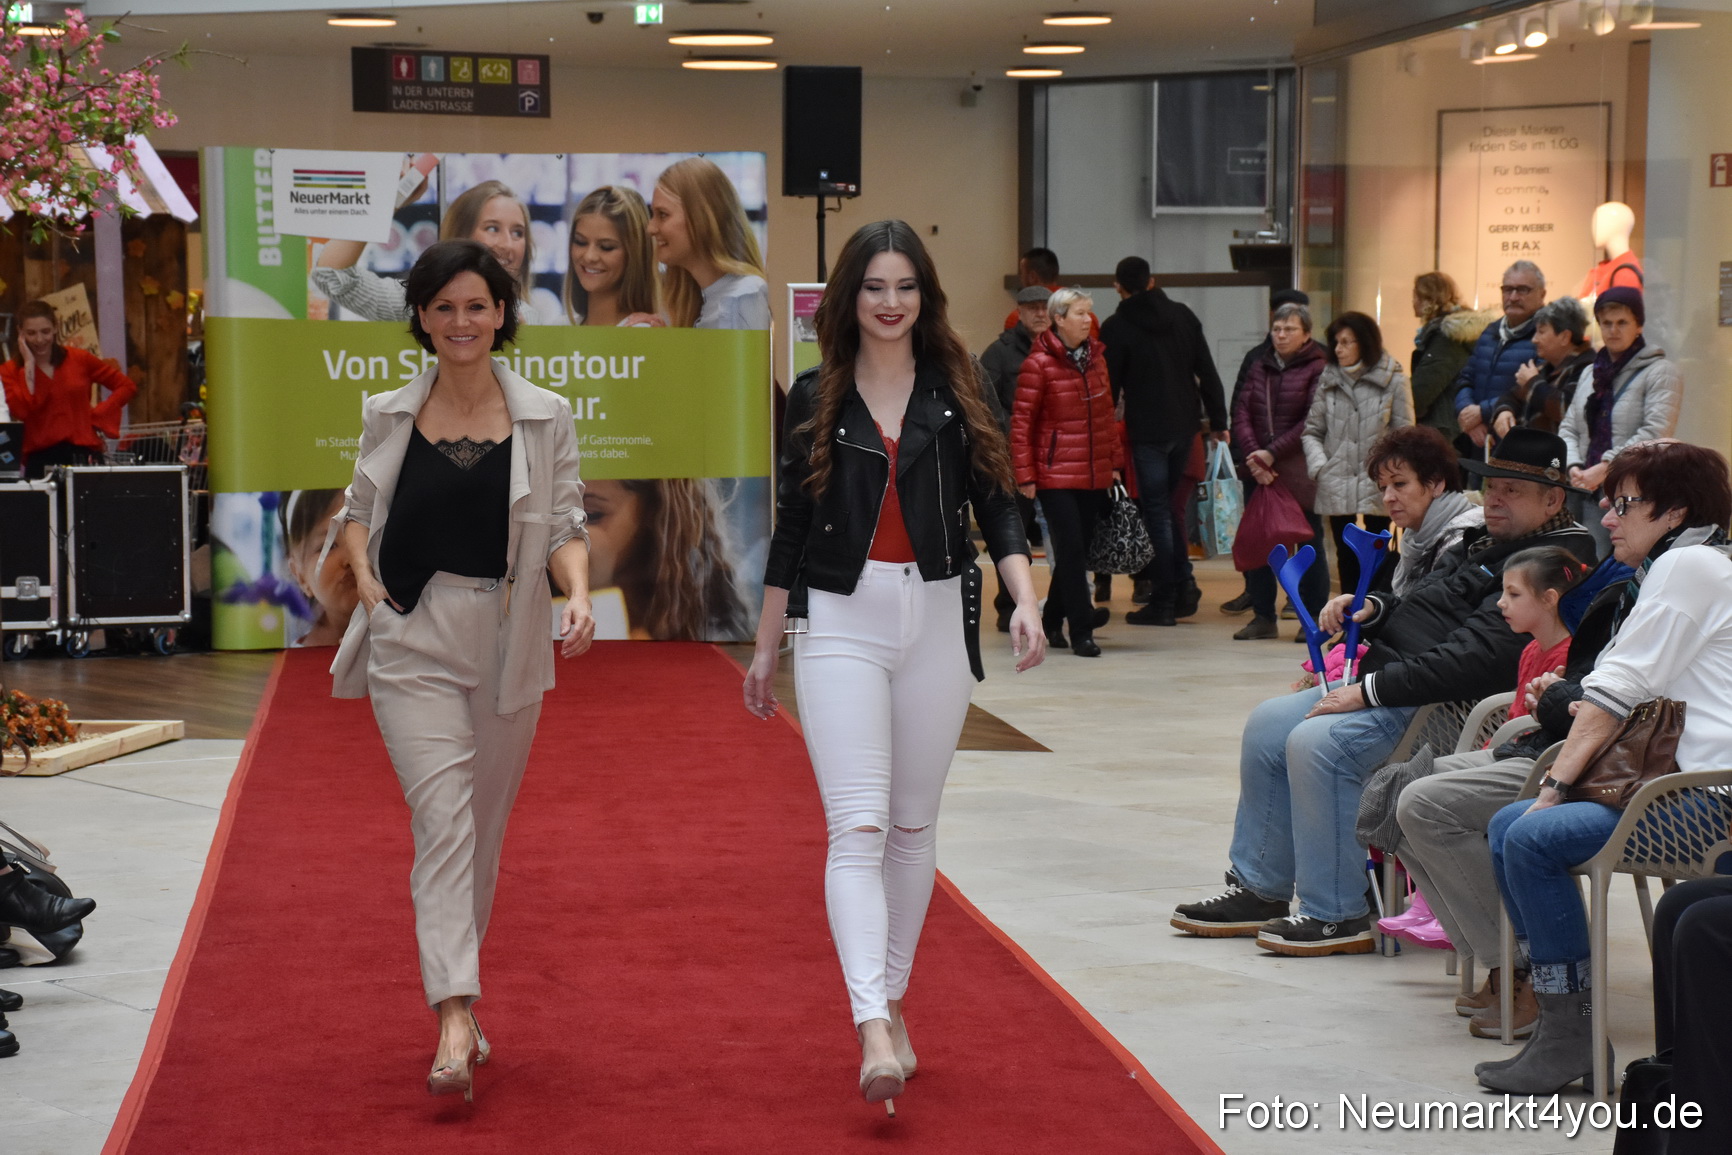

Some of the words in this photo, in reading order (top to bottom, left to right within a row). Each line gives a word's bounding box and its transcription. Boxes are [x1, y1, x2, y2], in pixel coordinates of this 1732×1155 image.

[392, 86, 402, 96] IN
[404, 86, 422, 97] DER
[426, 87, 474, 98] UNTEREN
[392, 99, 474, 112] LADENSTRASSE
[1482, 125, 1516, 138] Diese
[1521, 124, 1565, 137] Marken
[1469, 141, 1505, 152] finden
[1509, 139, 1528, 151] Sie
[1532, 140, 1546, 150] im
[1493, 165, 1510, 176] Für
[290, 190, 371, 206] NeuerMarkt
[294, 207, 309, 215] Alles
[328, 208, 349, 216] einem
[350, 208, 368, 216] Dach.
[1489, 224, 1519, 234] GERRY
[1522, 223, 1554, 233] WEBER
[1501, 241, 1541, 251] BRAX
[322, 350, 388, 380] Von
[316, 437, 327, 448] Im
[589, 434, 654, 446] Gastronomie,
[600, 448, 630, 459] dabei.
